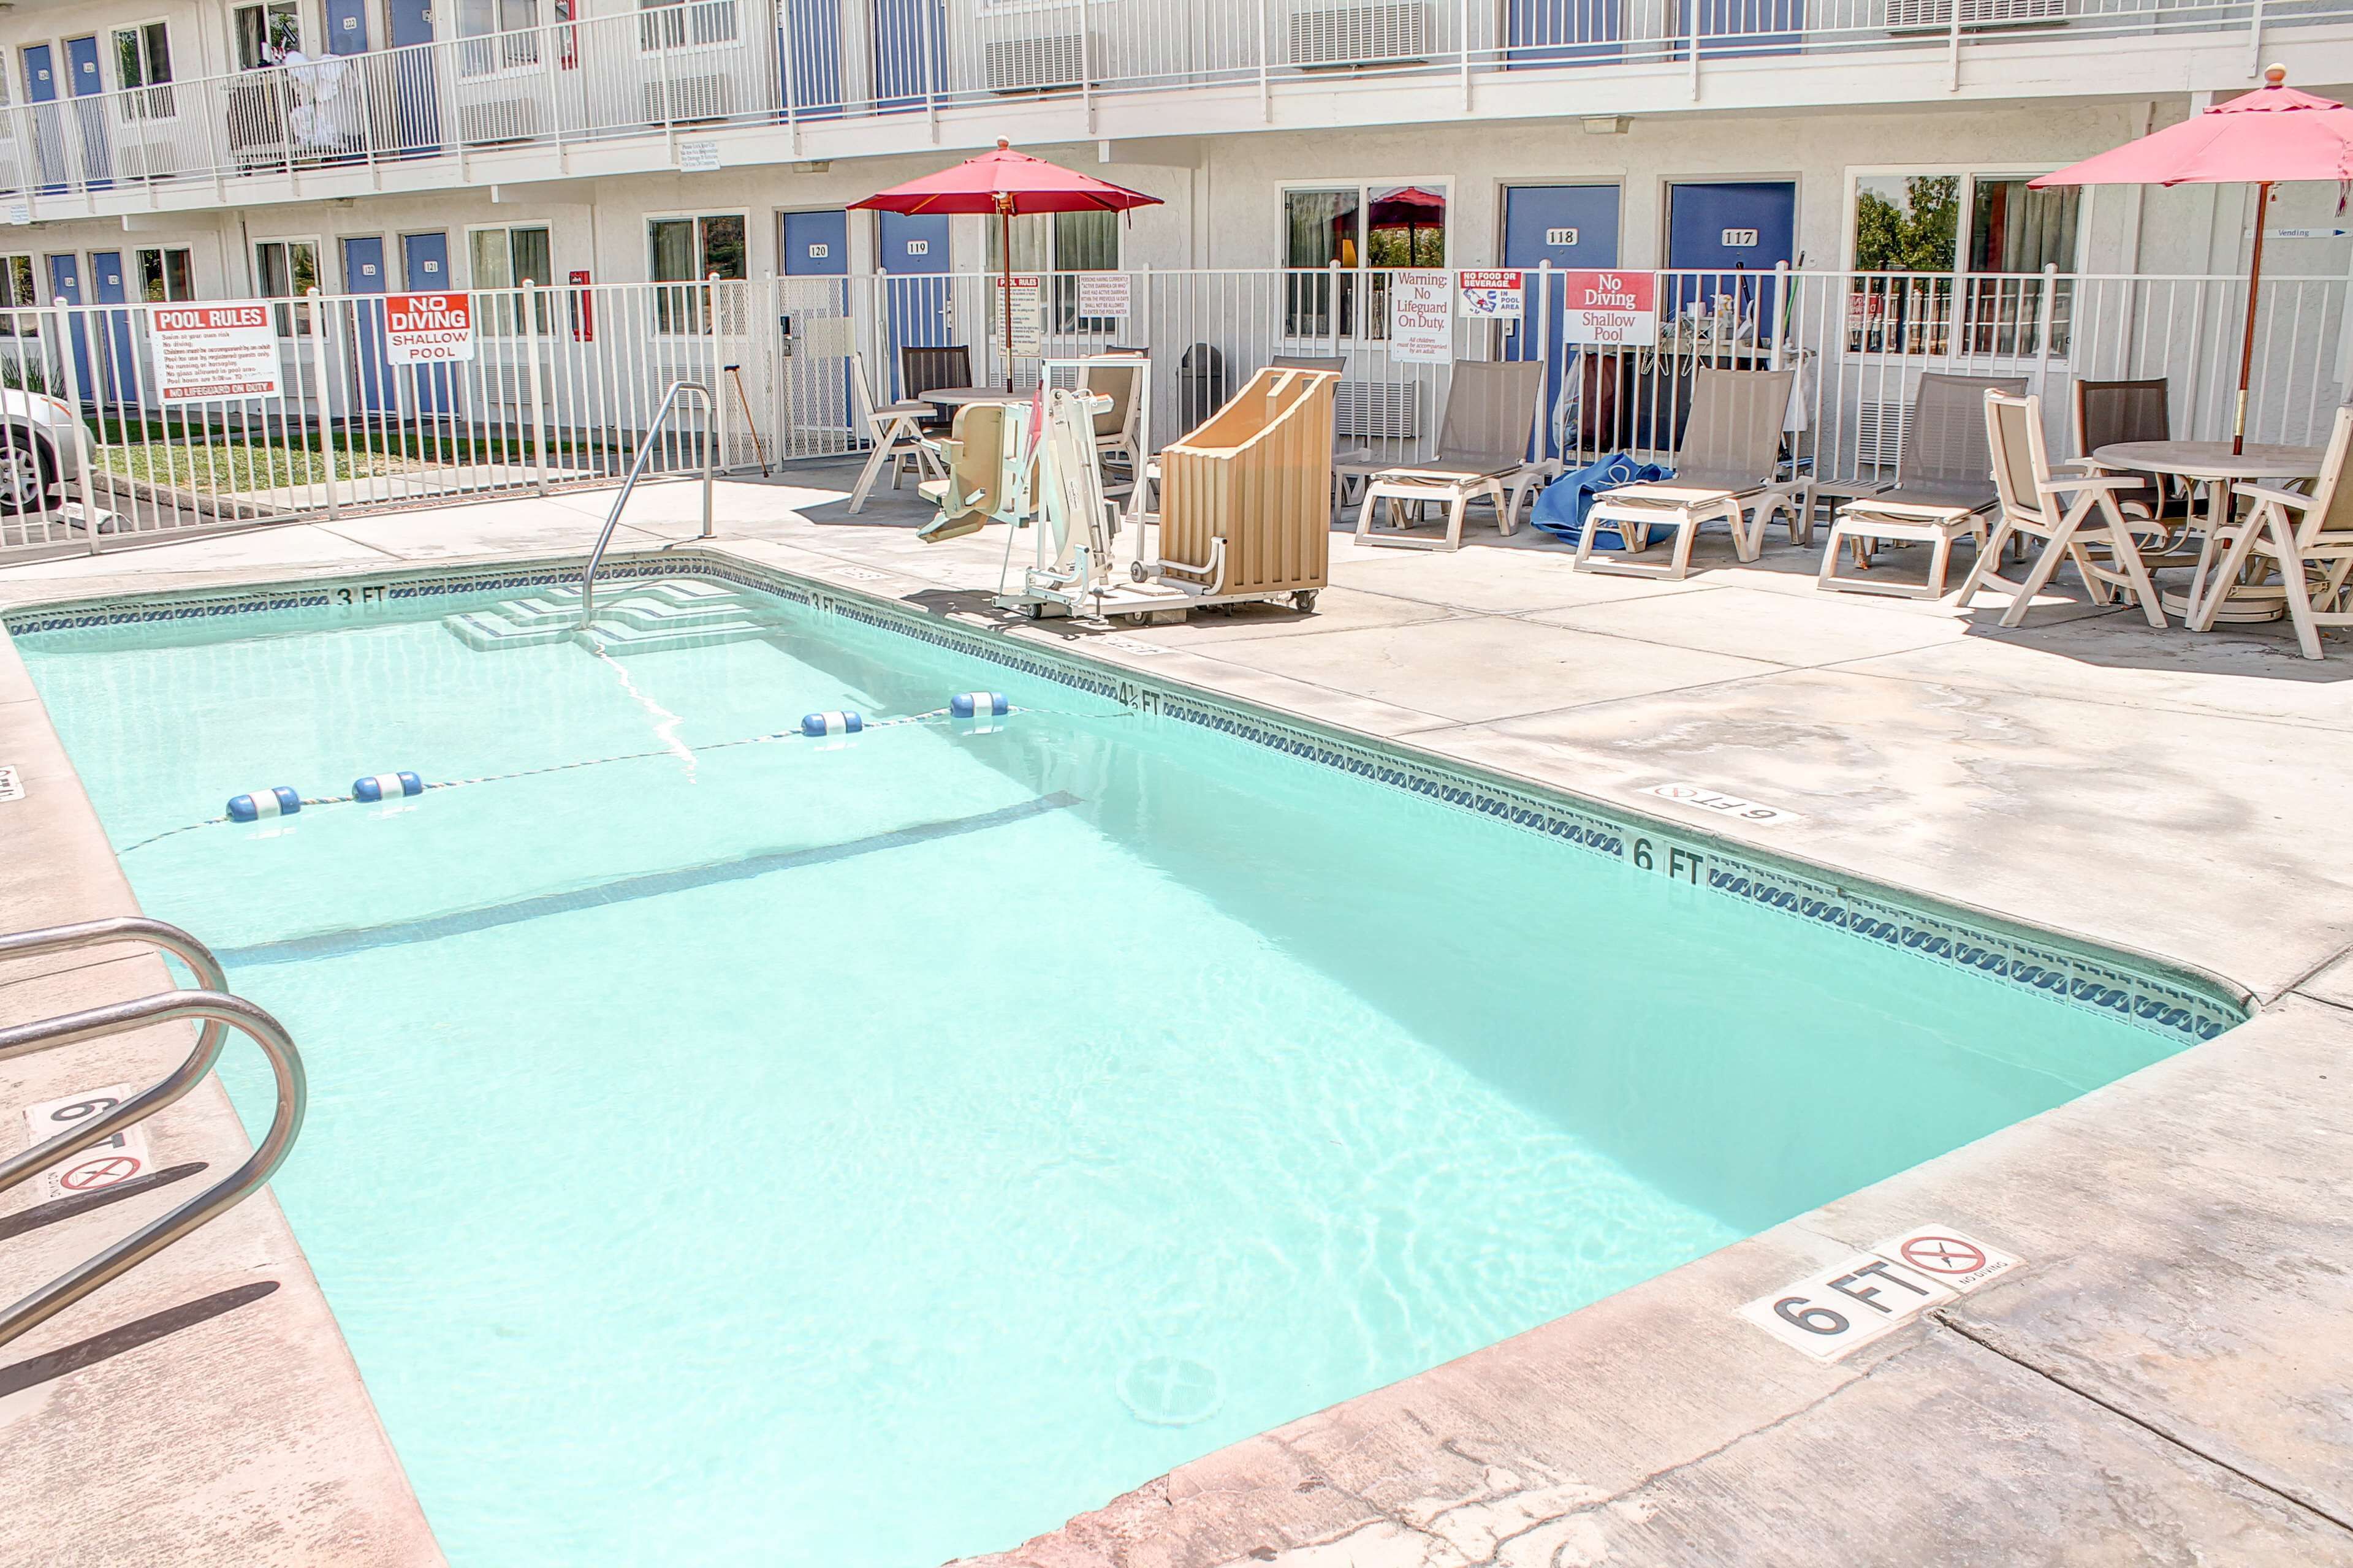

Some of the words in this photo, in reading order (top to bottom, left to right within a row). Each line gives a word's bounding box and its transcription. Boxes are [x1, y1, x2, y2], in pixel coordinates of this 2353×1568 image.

[1549, 231, 1574, 243] 118
[1725, 232, 1753, 244] 117
[812, 246, 826, 256] 120
[910, 243, 926, 253] 119
[1397, 272, 1447, 289] Warning:
[1598, 274, 1622, 290] No
[1414, 287, 1431, 300] No
[1584, 289, 1636, 310] Diving
[408, 297, 447, 312] NO
[1397, 300, 1447, 316] Lifeguard
[159, 311, 207, 329] POOL
[209, 309, 262, 327] RULES
[391, 309, 466, 330] DIVING
[1398, 314, 1415, 327] On
[1418, 316, 1445, 331] Duty.
[1583, 312, 1636, 327] Shallow
[392, 331, 468, 346] SHALLOW
[1594, 327, 1623, 341] Pool
[409, 347, 455, 358] POOL
[170, 388, 183, 398] NO
[184, 385, 230, 396] LIFEGUARD
[232, 384, 245, 393] ON
[246, 382, 268, 393] DUTY
[338, 588, 352, 605] 3
[363, 586, 386, 603] FT
[813, 593, 819, 610] 3
[823, 596, 834, 615] FT
[1142, 689, 1160, 716] FT
[1689, 797, 1746, 809] FT
[1741, 809, 1777, 819] 6
[1633, 838, 1653, 870] 6
[1670, 847, 1703, 885] FT
[50, 1097, 119, 1121] 6
[1958, 1276, 1976, 1284] NO
[1974, 1261, 2008, 1278] DIVING
[1774, 1297, 1850, 1335] 6
[1826, 1260, 1930, 1313] FT
